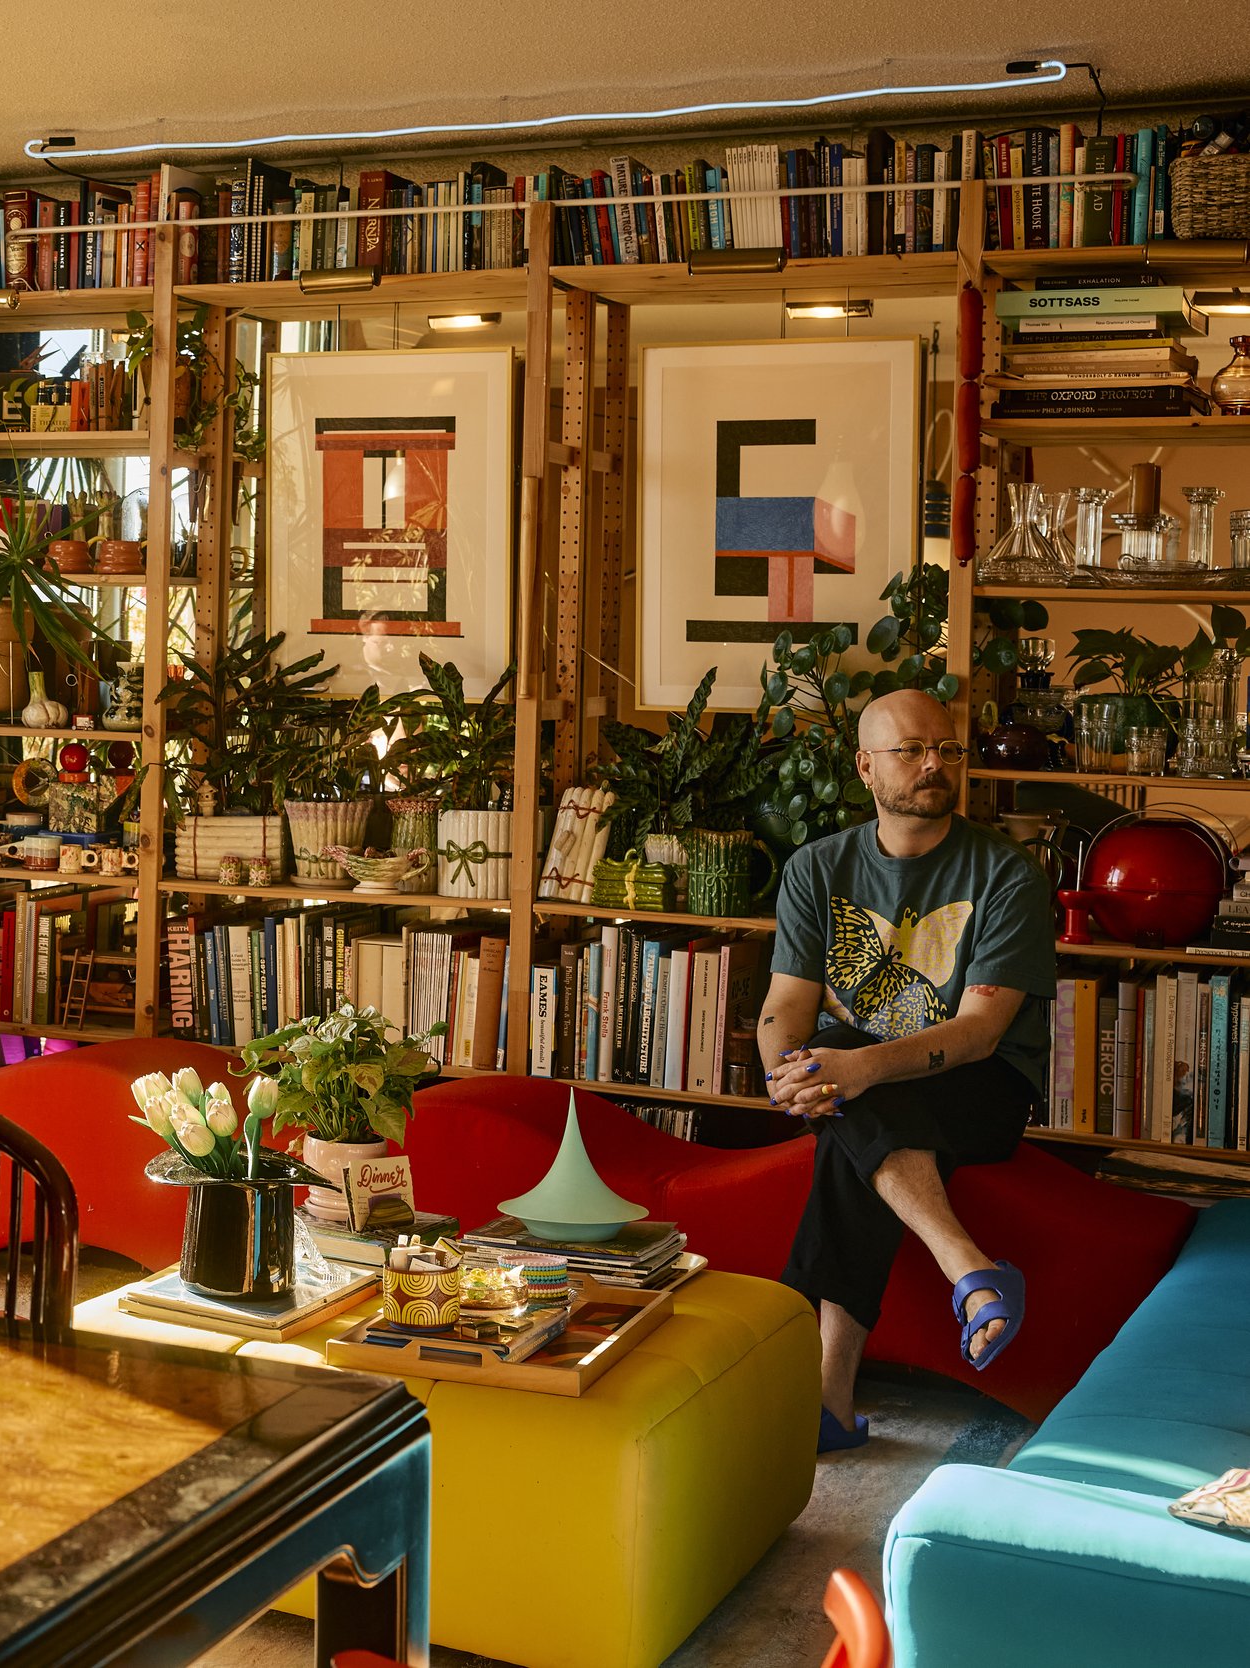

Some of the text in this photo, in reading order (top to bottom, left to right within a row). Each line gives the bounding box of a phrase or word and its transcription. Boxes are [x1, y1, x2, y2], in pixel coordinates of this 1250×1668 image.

[965, 134, 973, 149] Meet
[965, 149, 972, 158] Me
[1032, 147, 1037, 155] OF
[906, 152, 914, 203] LYDIA DVIS
[1014, 190, 1022, 226] polysecure
[1031, 165, 1043, 230] WTE HOUSE
[366, 197, 381, 252] NRNIA
[85, 212, 94, 276] POER MOVES
[1078, 277, 1122, 285] EXHALATION
[1029, 296, 1101, 309] SOTTSASS
[1024, 389, 1155, 402] THE OXFORD PROJECT
[1041, 405, 1096, 415] PHILIP JOHNSON
[36, 917, 50, 994] HOME HEAT MONEY GOD
[323, 926, 334, 990] GRIEF AND GRIEVANCE
[336, 928, 345, 991] GUERRILLA GIRLS
[632, 940, 640, 965] ITALIAN
[168, 933, 194, 1028] HARING
[564, 965, 573, 985] Philip
[631, 965, 639, 982] LIVING
[661, 971, 669, 995] TROMPE
[539, 974, 548, 1018] EAMES
[563, 987, 574, 1012] Johnson
[1168, 995, 1176, 1009] Dan
[601, 991, 611, 1039] Frank Stella
[616, 1004, 624, 1049] ARCHITECTURE
[639, 952, 656, 1074] FANTASTIC ARCHITECTURE
[1167, 1010, 1175, 1031] Flavin:
[1232, 1001, 1240, 1045] hyperwest
[563, 1020, 571, 1037] Texas
[658, 1023, 666, 1041] HOME
[1100, 1029, 1115, 1096] HEROIC
[1166, 1038, 1174, 1082] Retrospective
[356, 1164, 408, 1194] Dinner
